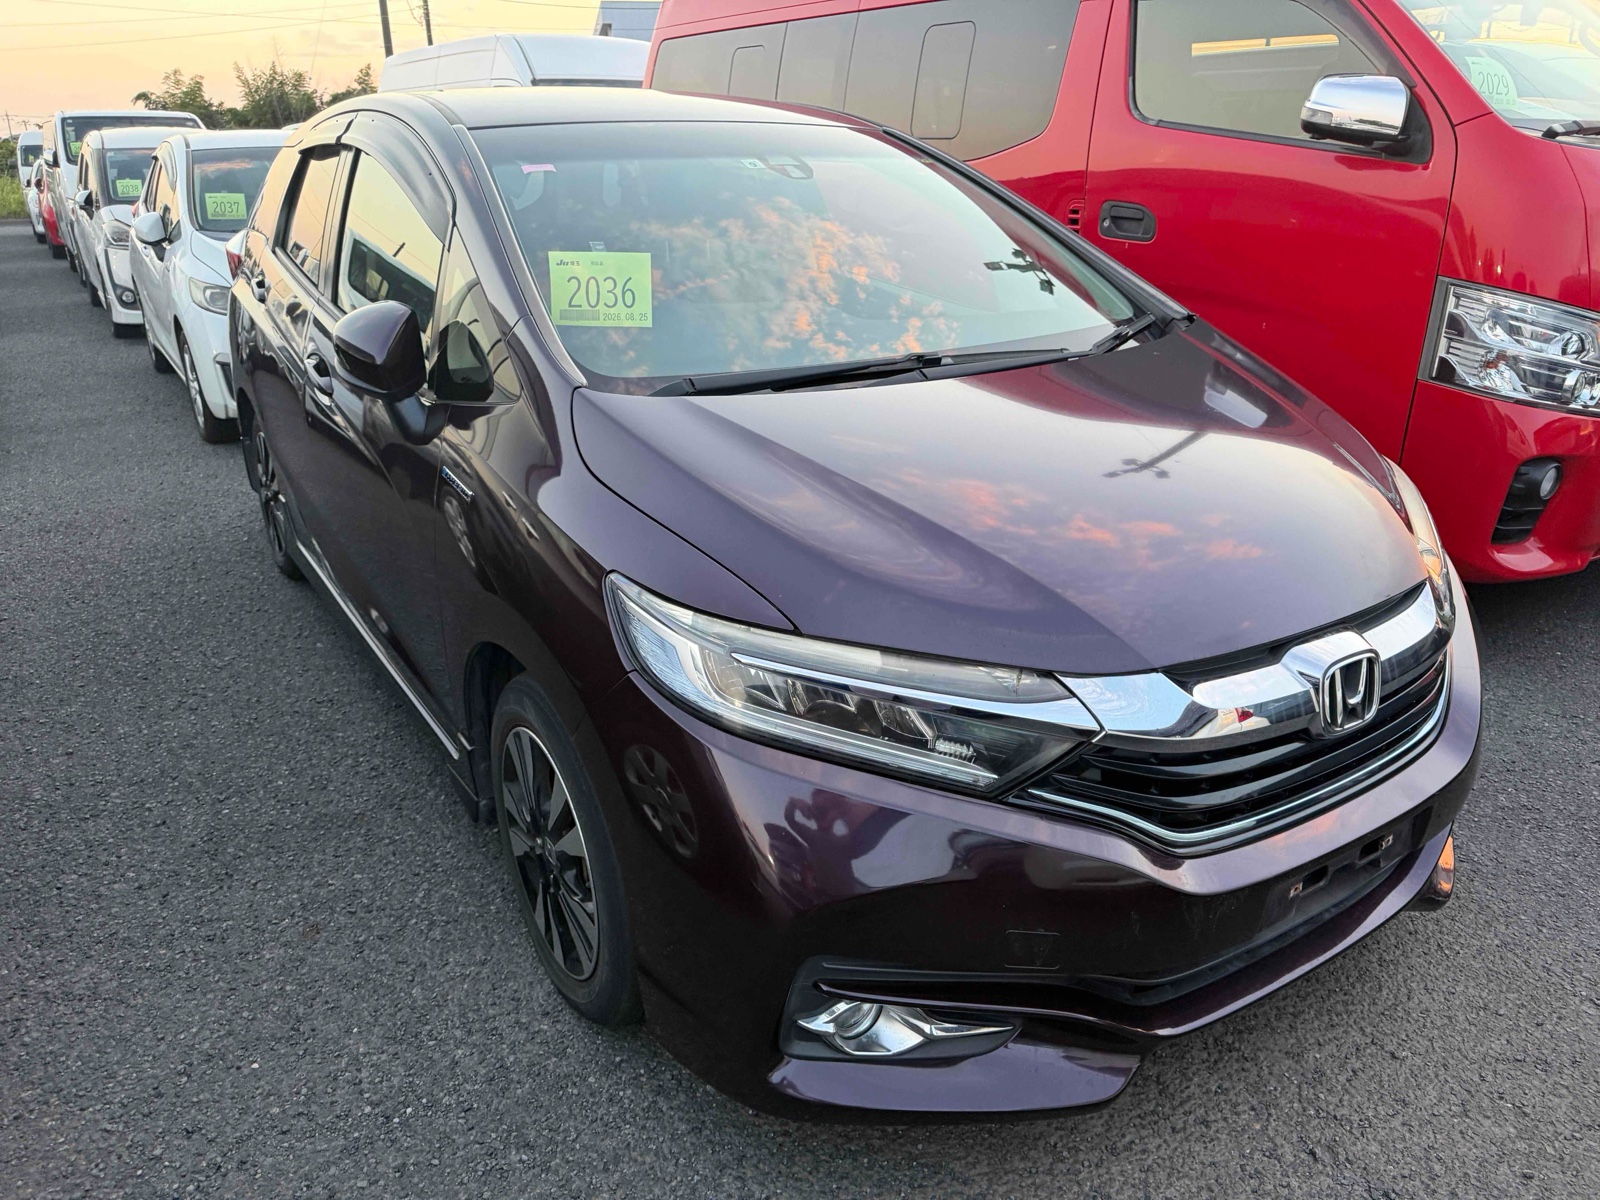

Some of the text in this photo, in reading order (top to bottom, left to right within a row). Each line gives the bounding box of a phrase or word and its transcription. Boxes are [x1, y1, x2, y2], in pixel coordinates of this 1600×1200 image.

[1478, 71, 1510, 96] 2029
[120, 184, 140, 193] 2038
[212, 201, 240, 214] 2037
[567, 275, 636, 309] 2036
